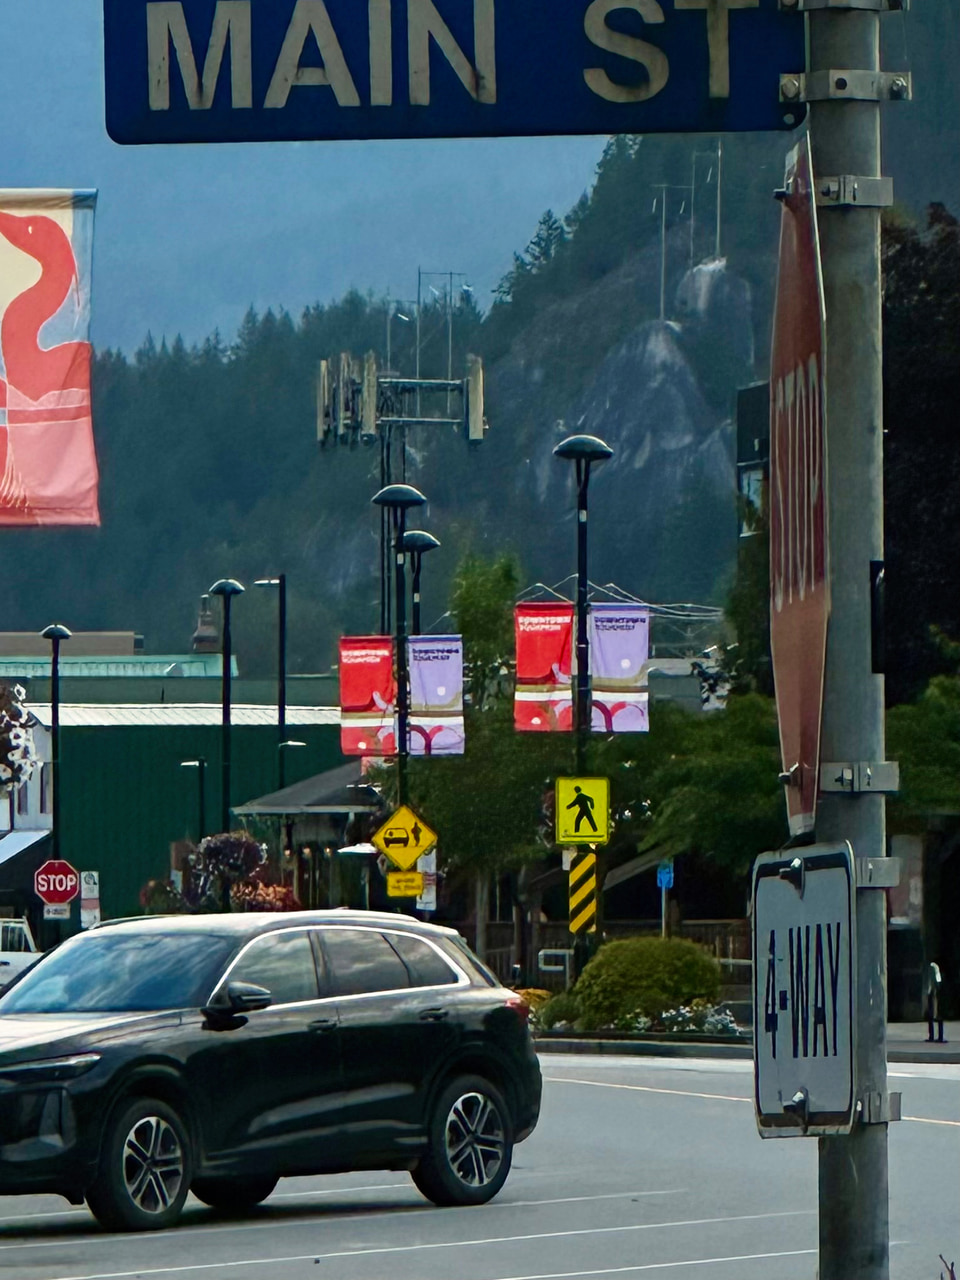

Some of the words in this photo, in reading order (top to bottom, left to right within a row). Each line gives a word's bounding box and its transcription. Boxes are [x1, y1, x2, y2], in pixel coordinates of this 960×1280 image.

[774, 352, 820, 613] STOP
[37, 874, 77, 892] STOP
[765, 922, 841, 1060] 4-WAY
